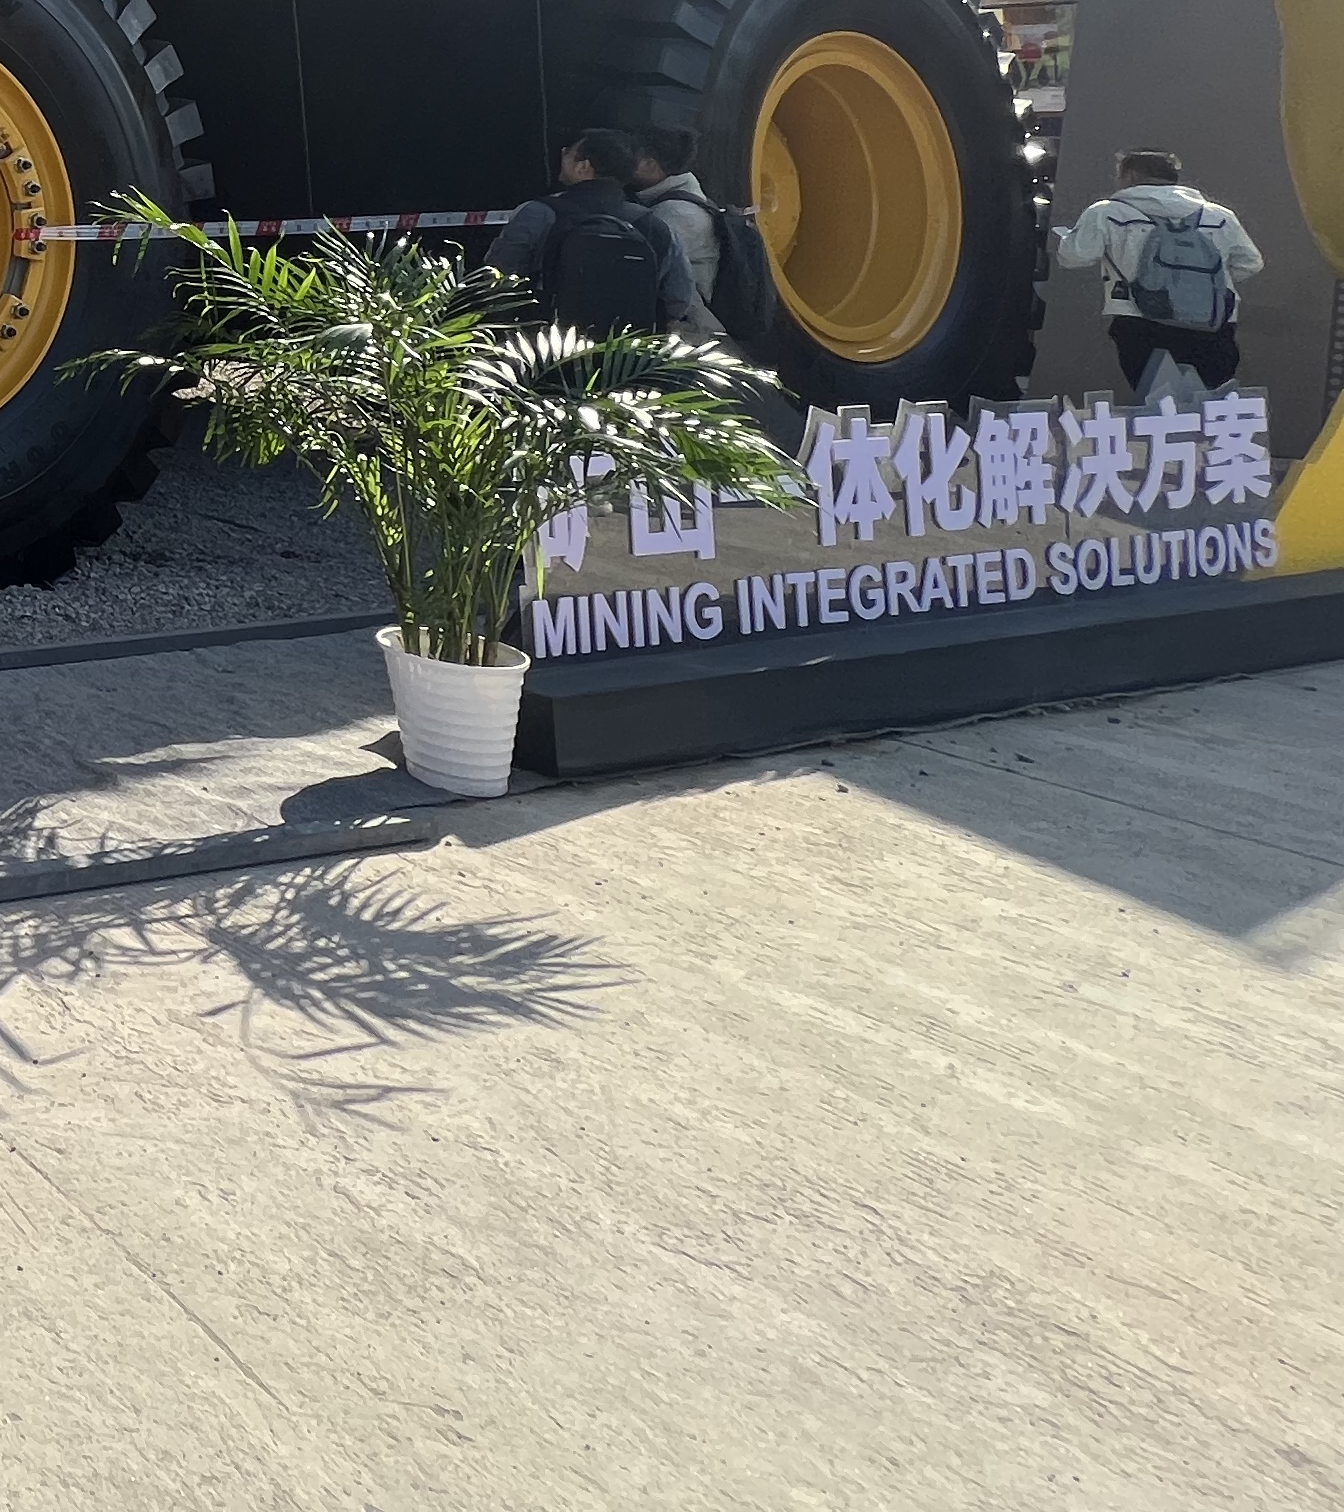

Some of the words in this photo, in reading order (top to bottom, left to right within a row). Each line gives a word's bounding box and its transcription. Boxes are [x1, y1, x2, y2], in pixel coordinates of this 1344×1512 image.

[531, 581, 724, 660] MINING
[737, 547, 1037, 636] INTEGRATED
[1047, 518, 1279, 597] SOLUTIONS
